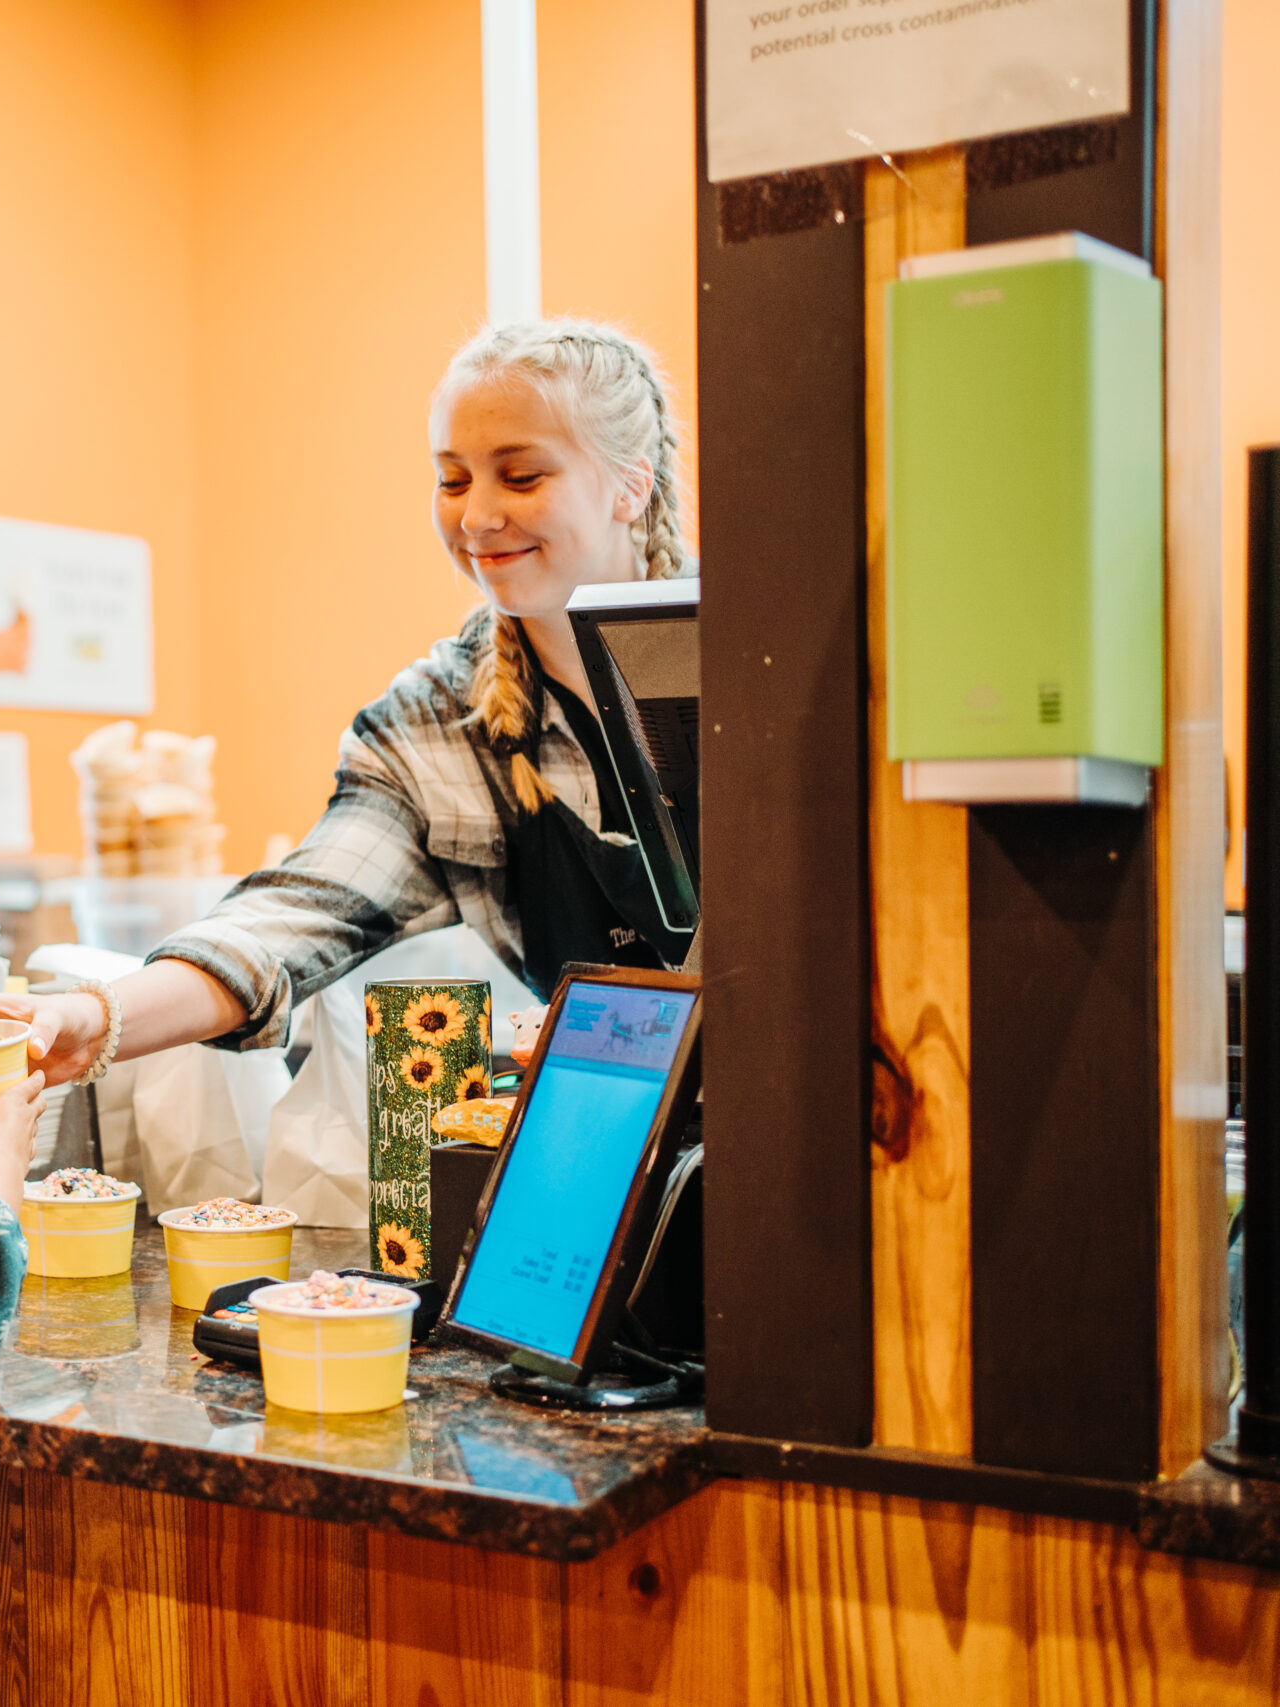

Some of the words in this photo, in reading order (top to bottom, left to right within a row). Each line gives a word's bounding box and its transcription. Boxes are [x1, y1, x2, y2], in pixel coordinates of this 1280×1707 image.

[749, 6, 792, 31] your
[750, 26, 836, 62] potential
[841, 22, 893, 41] cross
[609, 927, 636, 948] The
[438, 1111, 463, 1128] ICE
[472, 1112, 507, 1132] CRE
